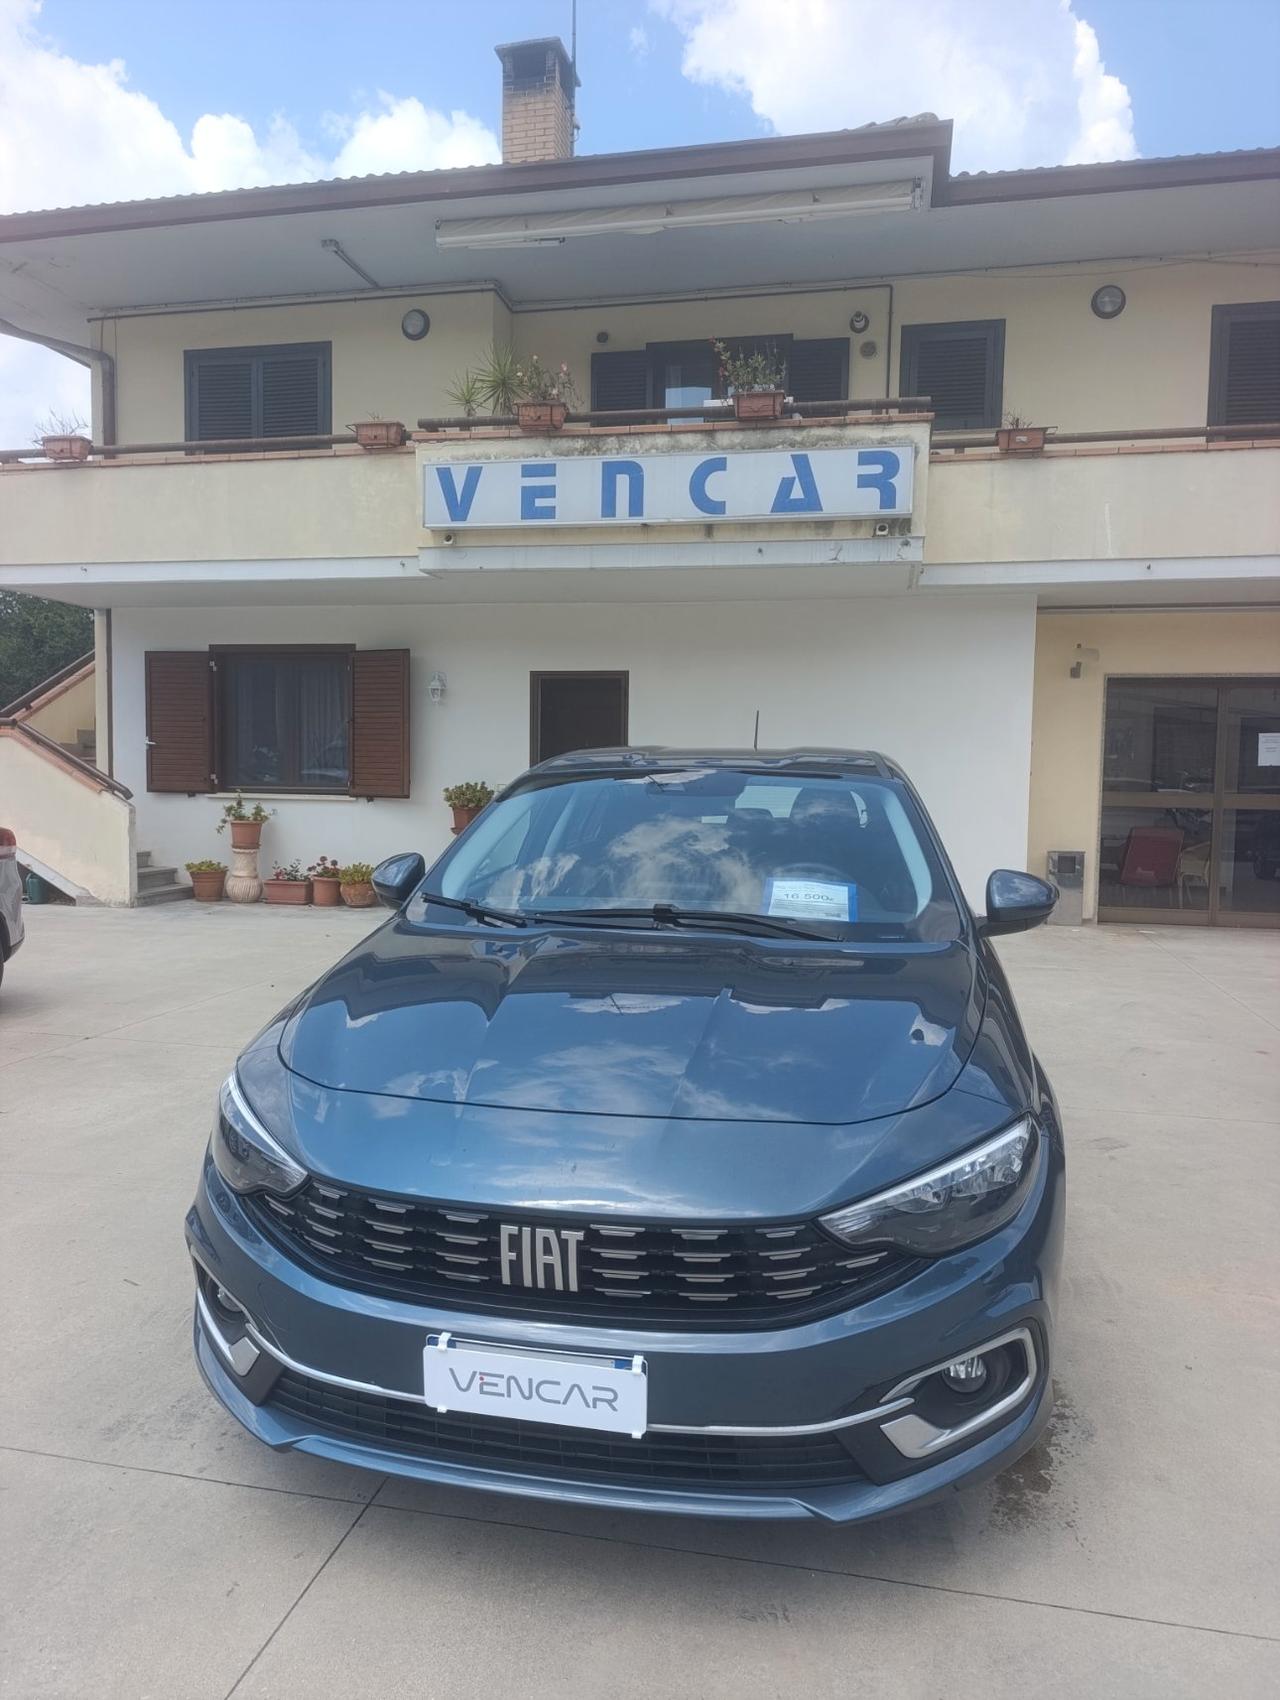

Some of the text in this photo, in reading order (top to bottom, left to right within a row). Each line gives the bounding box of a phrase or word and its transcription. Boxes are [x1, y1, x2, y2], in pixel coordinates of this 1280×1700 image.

[436, 450, 901, 522] VENCAR
[500, 1224, 585, 1292] FIAT
[449, 1367, 619, 1412] VENCAR
